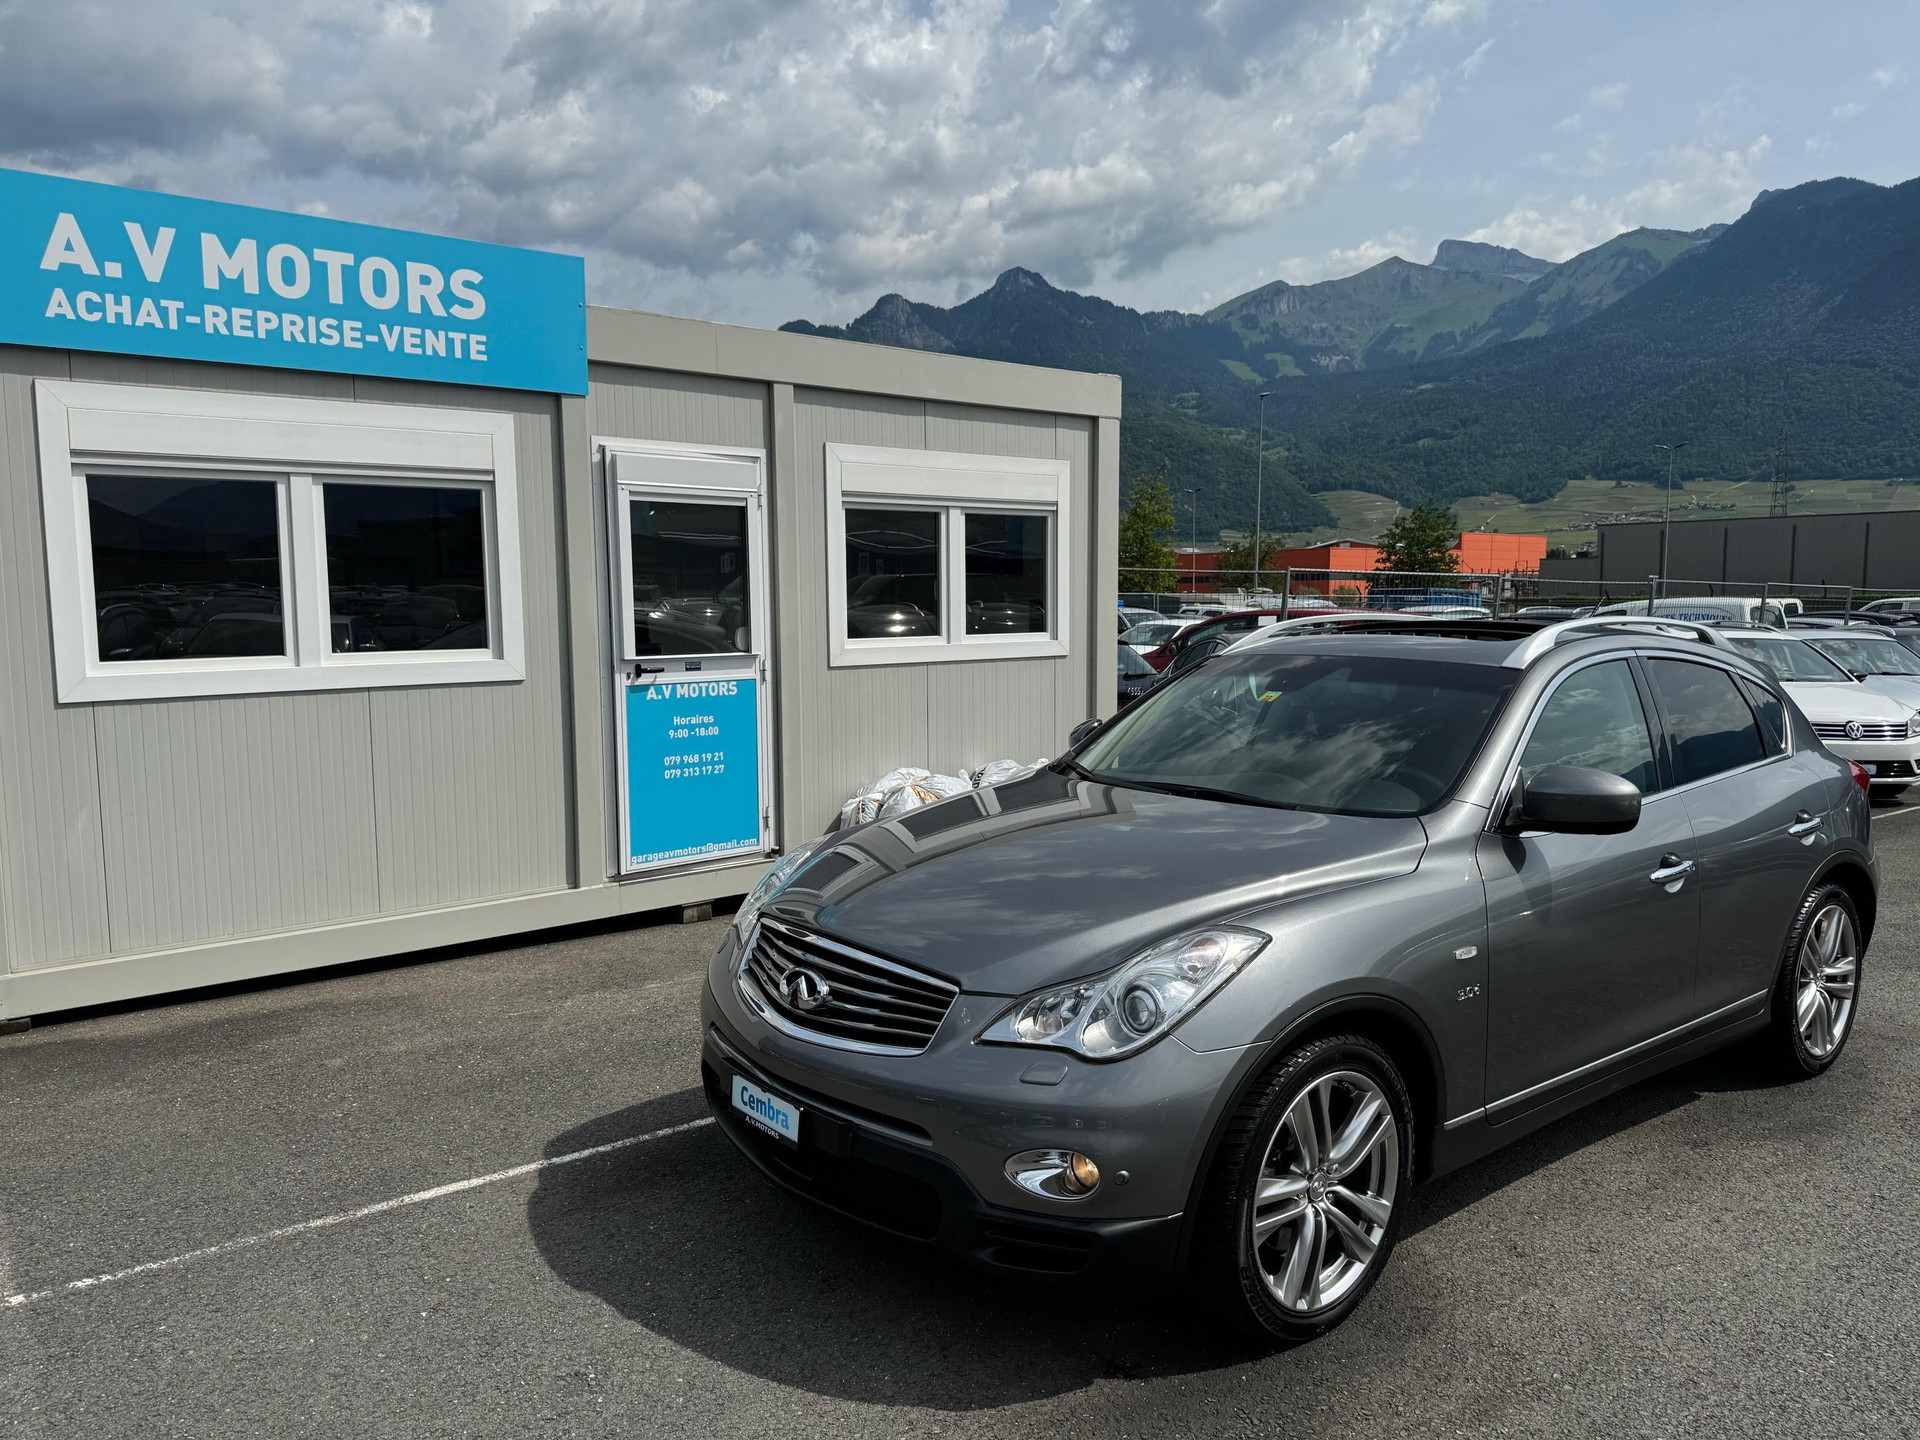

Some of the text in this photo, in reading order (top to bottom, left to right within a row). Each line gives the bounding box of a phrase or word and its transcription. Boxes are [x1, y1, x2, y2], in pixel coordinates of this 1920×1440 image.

[39, 212, 486, 320] A.V MOTORS
[44, 287, 488, 362] ACHAT-REPRISE-VENTE
[646, 681, 738, 700] A.V MOTORS
[673, 714, 714, 726] Horaires
[668, 729, 688, 739] 9:00
[664, 752, 724, 766] 079 968 19 21
[664, 765, 725, 779] 079 313 17 27
[631, 837, 758, 865] garageavmotors@gmail.com
[740, 1085, 790, 1131] Cembra
